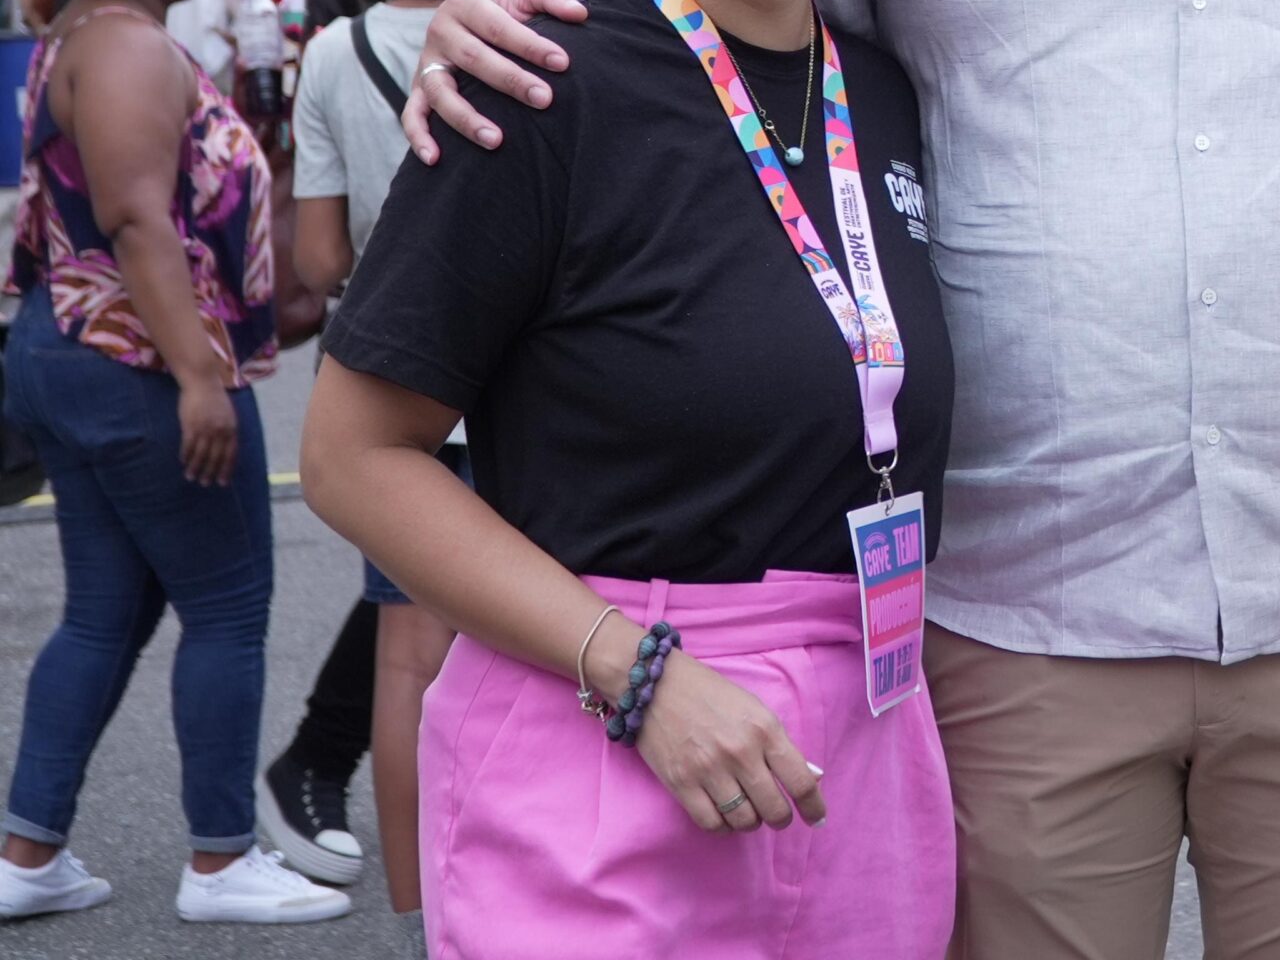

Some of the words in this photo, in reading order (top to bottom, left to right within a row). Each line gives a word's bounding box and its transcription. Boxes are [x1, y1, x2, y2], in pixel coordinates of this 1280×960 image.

[884, 173, 927, 225] CAY
[846, 229, 871, 272] CAYE
[864, 544, 892, 577] CAYE
[892, 522, 920, 567] TEAM
[873, 651, 895, 698] TEAM
